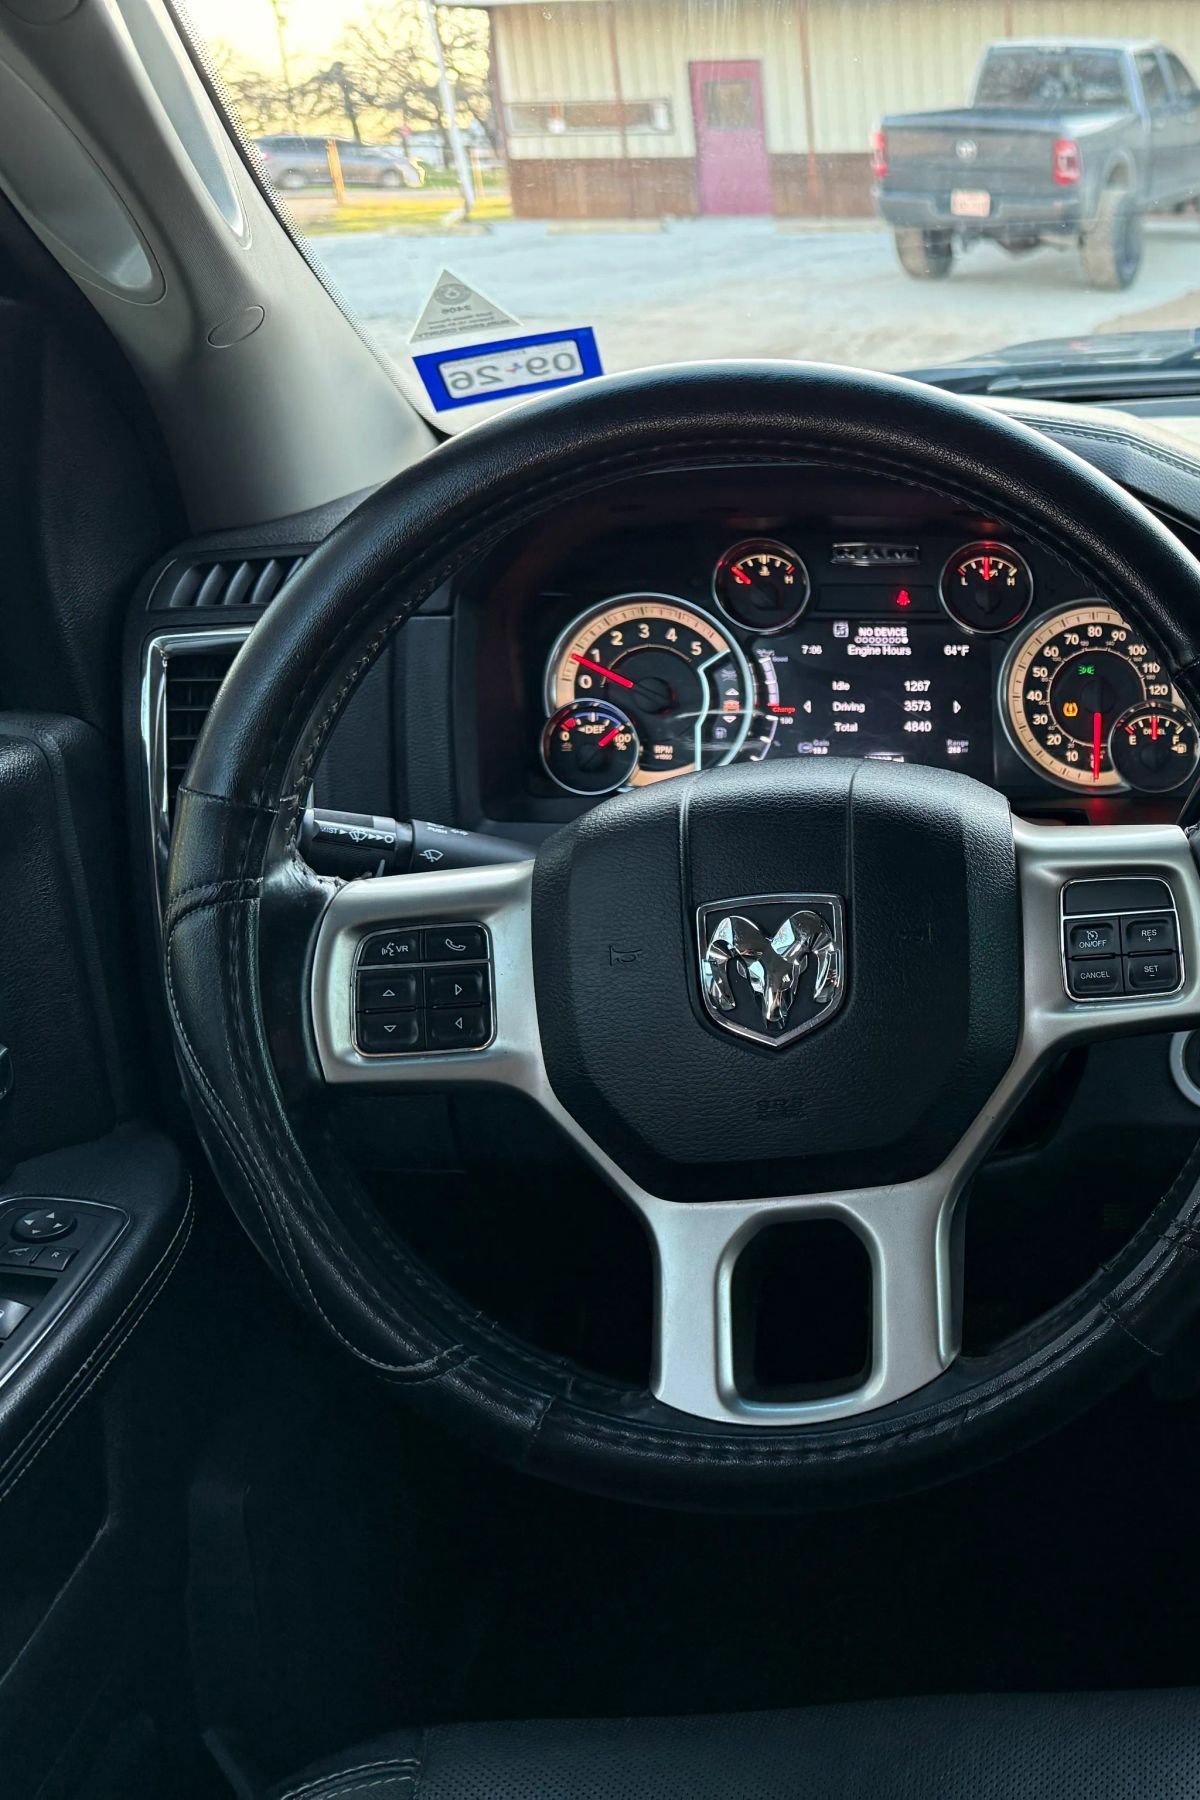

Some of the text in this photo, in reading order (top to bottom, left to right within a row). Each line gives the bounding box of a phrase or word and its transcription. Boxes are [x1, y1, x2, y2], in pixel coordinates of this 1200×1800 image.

[784, 574, 794, 584] H
[961, 576, 968, 586] L
[1006, 577, 1015, 586] H
[638, 623, 650, 638] 3
[665, 628, 678, 642] 4
[858, 627, 907, 637] NO DEVICE
[1087, 626, 1102, 637] 80
[610, 630, 623, 646] 2
[1064, 634, 1079, 645] 70
[1111, 631, 1126, 642] 90
[691, 641, 702, 656] 5
[847, 644, 912, 657] Engine Hours
[1043, 646, 1059, 657] 60
[1127, 645, 1147, 656] 100
[590, 648, 600, 663] 1
[1032, 667, 1047, 678] 50
[1142, 663, 1160, 673] 110
[578, 674, 592, 689] 0
[832, 681, 850, 691] Idle
[904, 680, 930, 692] 1267
[1026, 690, 1042, 701] 40
[1149, 685, 1168, 696] 120
[832, 701, 866, 713] Driving
[904, 700, 931, 712] 3573
[1033, 714, 1048, 725] 30
[585, 725, 606, 734] DEF
[833, 722, 858, 732] Total
[903, 721, 932, 732] 4840
[561, 732, 570, 741] 0
[614, 734, 631, 743] 100
[1046, 735, 1061, 745] 20
[1128, 735, 1136, 745] E
[1172, 735, 1179, 744] F
[946, 739, 969, 748] Range
[654, 745, 673, 754] RPM
[1066, 751, 1078, 762] 10
[1141, 929, 1157, 937] RES
[395, 945, 409, 953] VR
[1079, 940, 1107, 948] ON/OFF
[1143, 965, 1159, 973] SET
[1080, 971, 1110, 980] CANCEL
